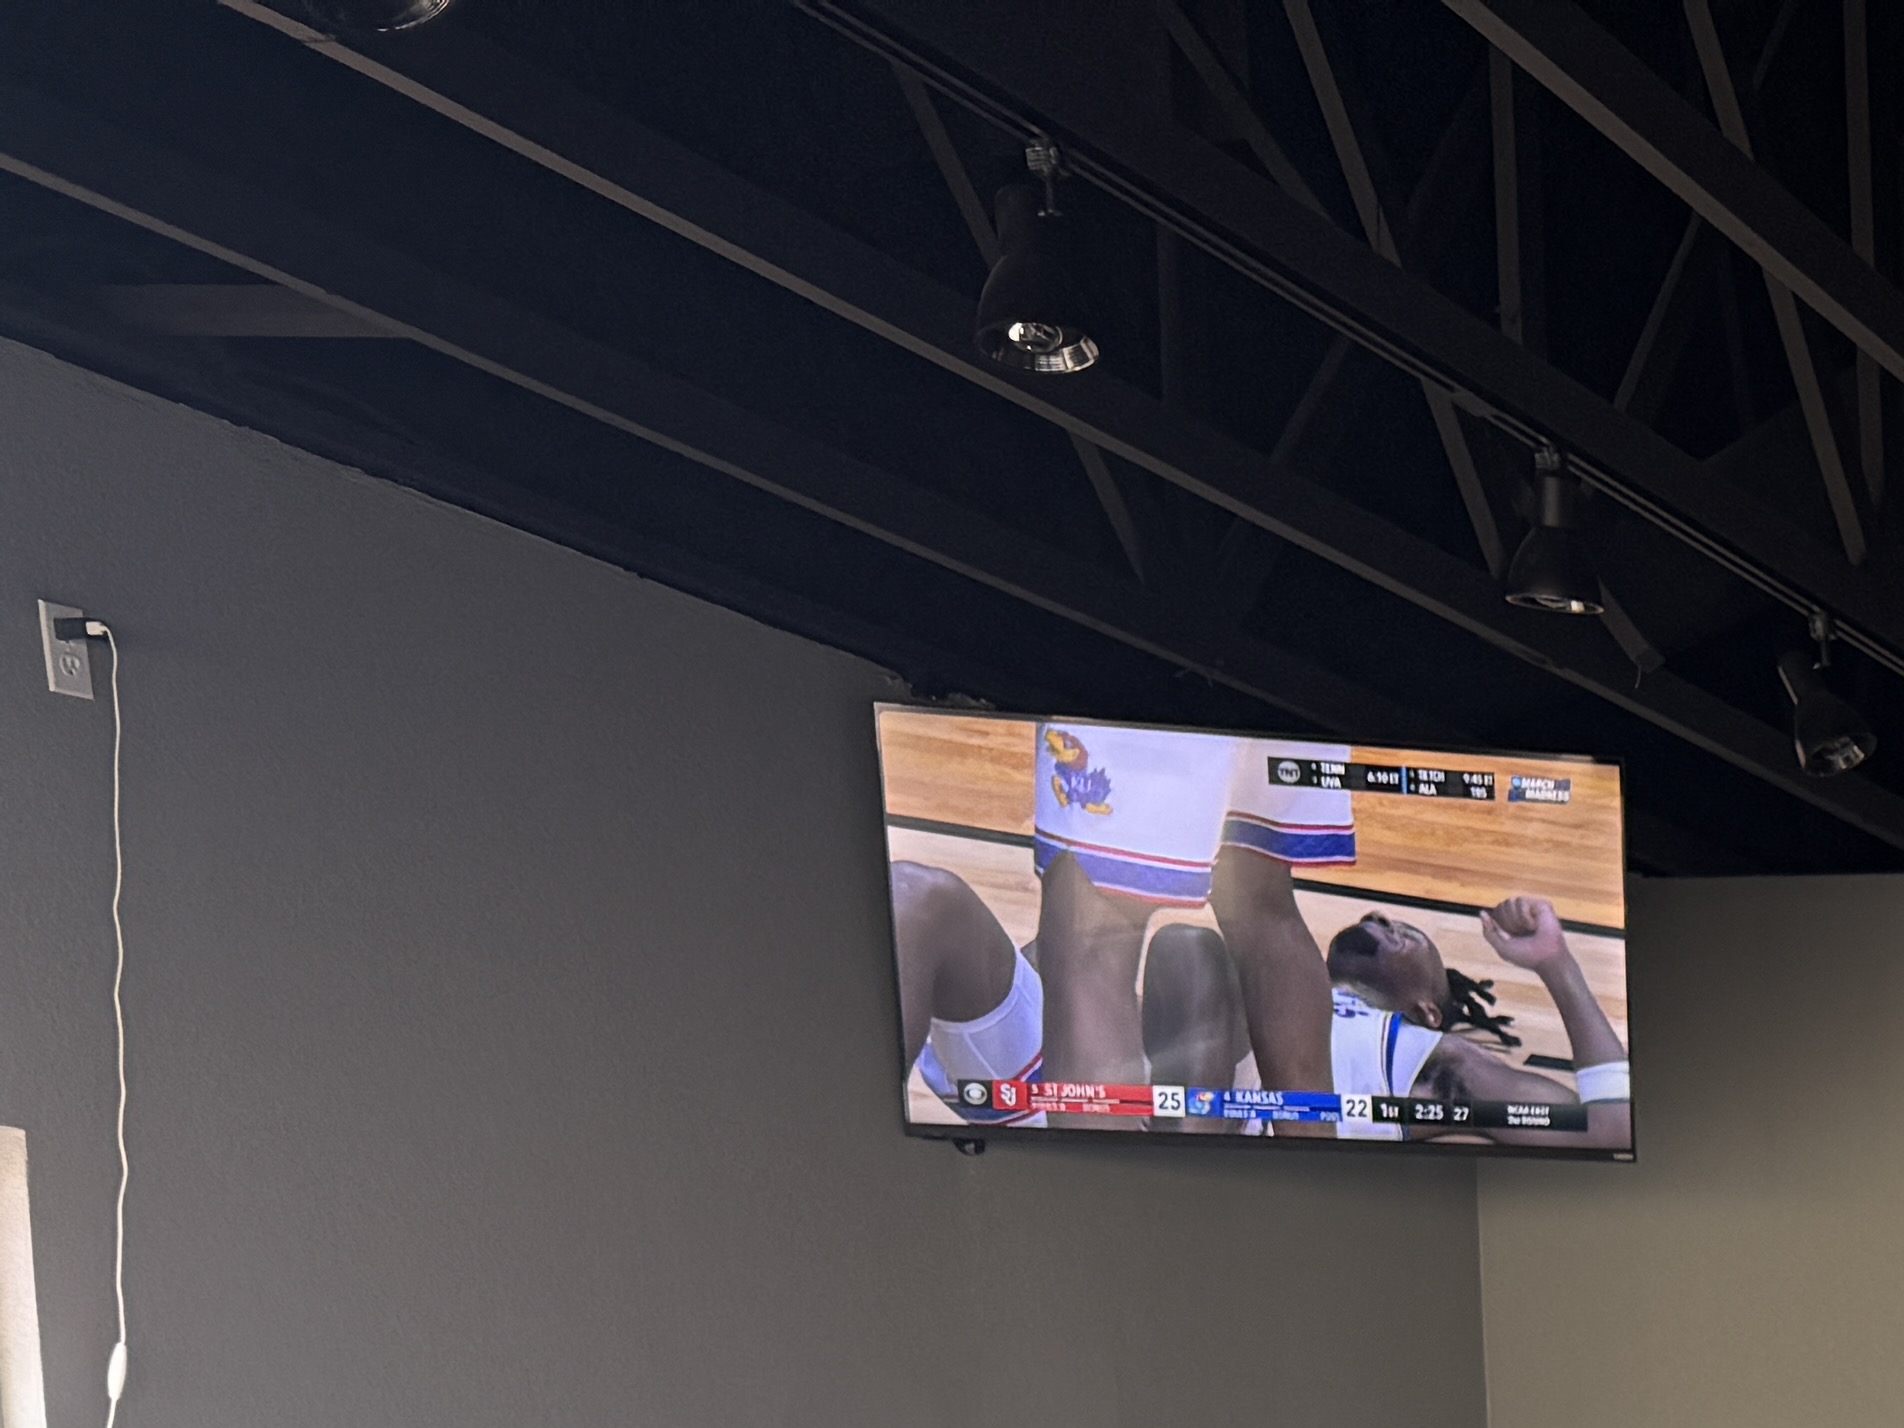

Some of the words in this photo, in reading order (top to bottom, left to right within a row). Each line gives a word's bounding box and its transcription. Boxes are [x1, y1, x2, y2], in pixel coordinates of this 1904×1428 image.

[1158, 1091, 1182, 1111] 25
[1235, 1091, 1284, 1106] KANSAS
[1345, 1099, 1367, 1118] 22
[1414, 1104, 1444, 1120] 2:25
[1453, 1106, 1469, 1121] 27
